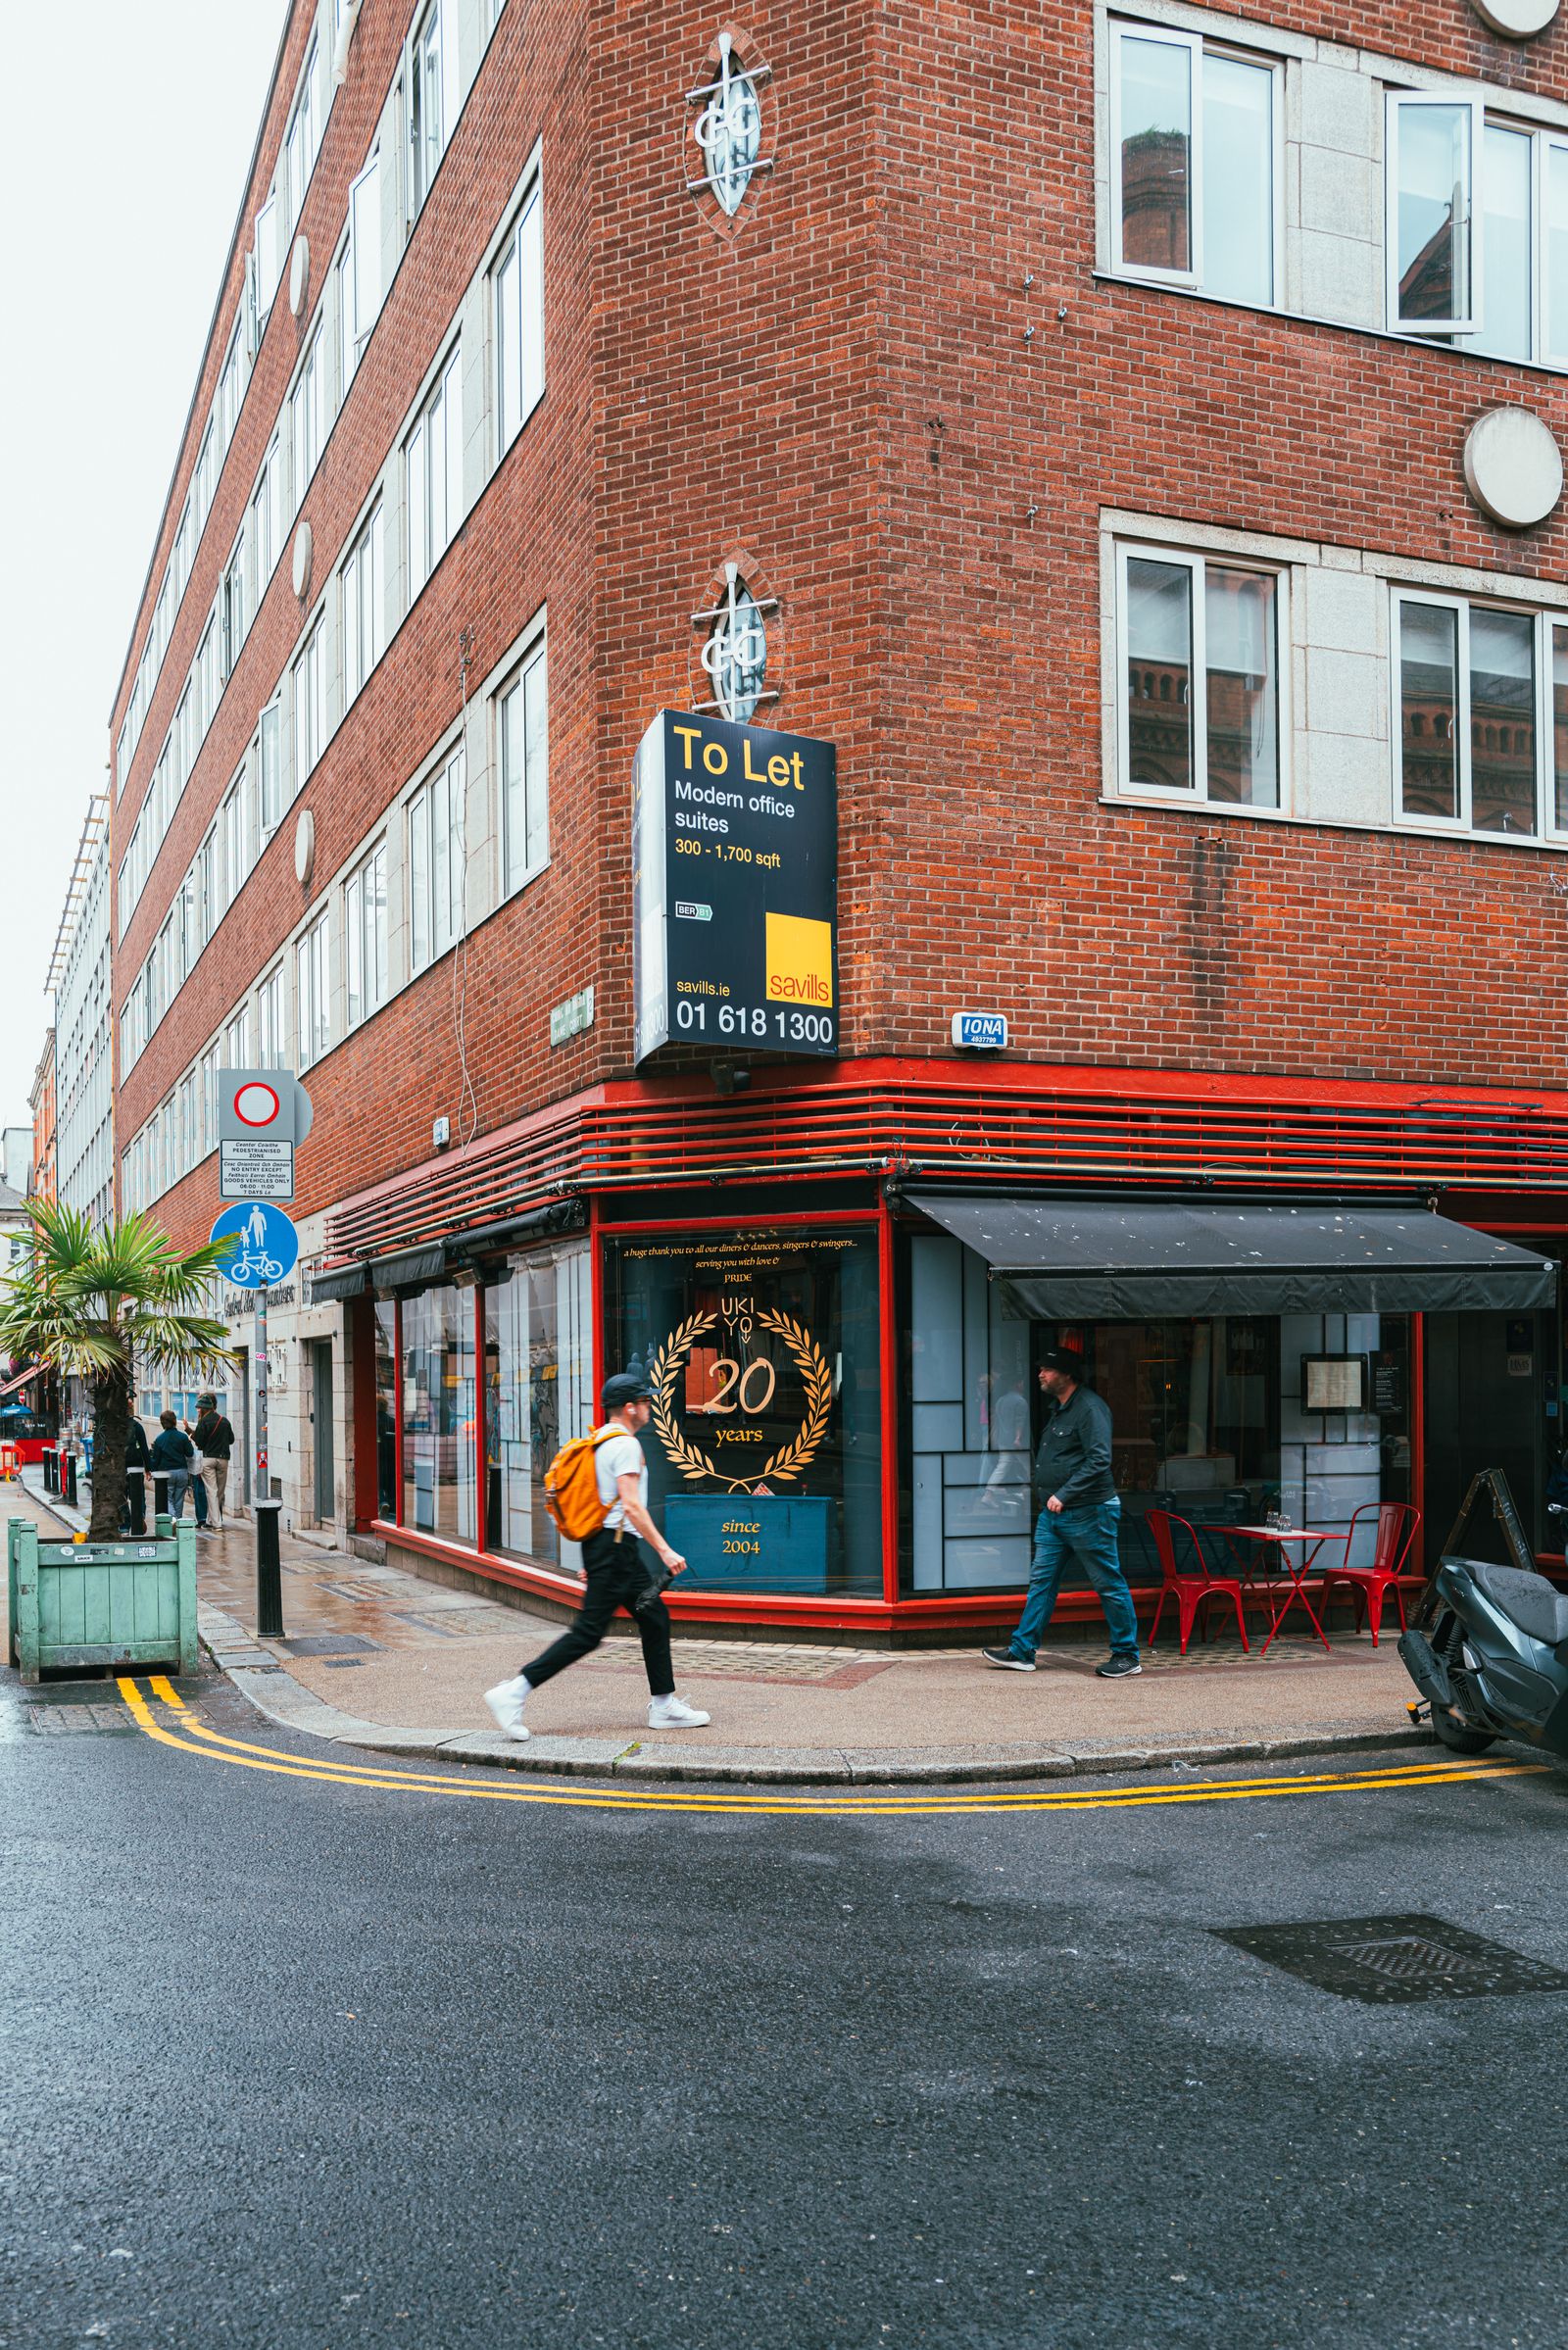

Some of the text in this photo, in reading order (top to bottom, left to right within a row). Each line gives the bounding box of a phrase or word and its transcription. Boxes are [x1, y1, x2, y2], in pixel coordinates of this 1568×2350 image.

[673, 725, 805, 791] To Let
[674, 780, 743, 809] Modern
[749, 789, 795, 818] office
[674, 811, 729, 833] suites
[675, 838, 702, 857] 300
[715, 844, 753, 864] 1,700
[756, 849, 781, 868] sqft
[678, 906, 709, 917] BER B1
[676, 980, 730, 998] savills.ie
[770, 974, 829, 1002] savills
[676, 1001, 833, 1045] 01 618 1300
[964, 1019, 1002, 1035] IONA
[630, 1248, 648, 1258] huge
[649, 1247, 670, 1255] thank
[670, 1247, 684, 1257] you
[695, 1245, 704, 1254] all
[719, 1244, 742, 1252] diners
[743, 1243, 750, 1251] &
[782, 1241, 809, 1251] singers
[696, 1256, 780, 1270] serving you with love &
[723, 1273, 753, 1284] PRIDE
[721, 1297, 754, 1315] UKI
[702, 1356, 776, 1414] 20
[715, 1427, 763, 1448] years
[721, 1519, 760, 1533] since
[722, 1541, 760, 1554] 2004
